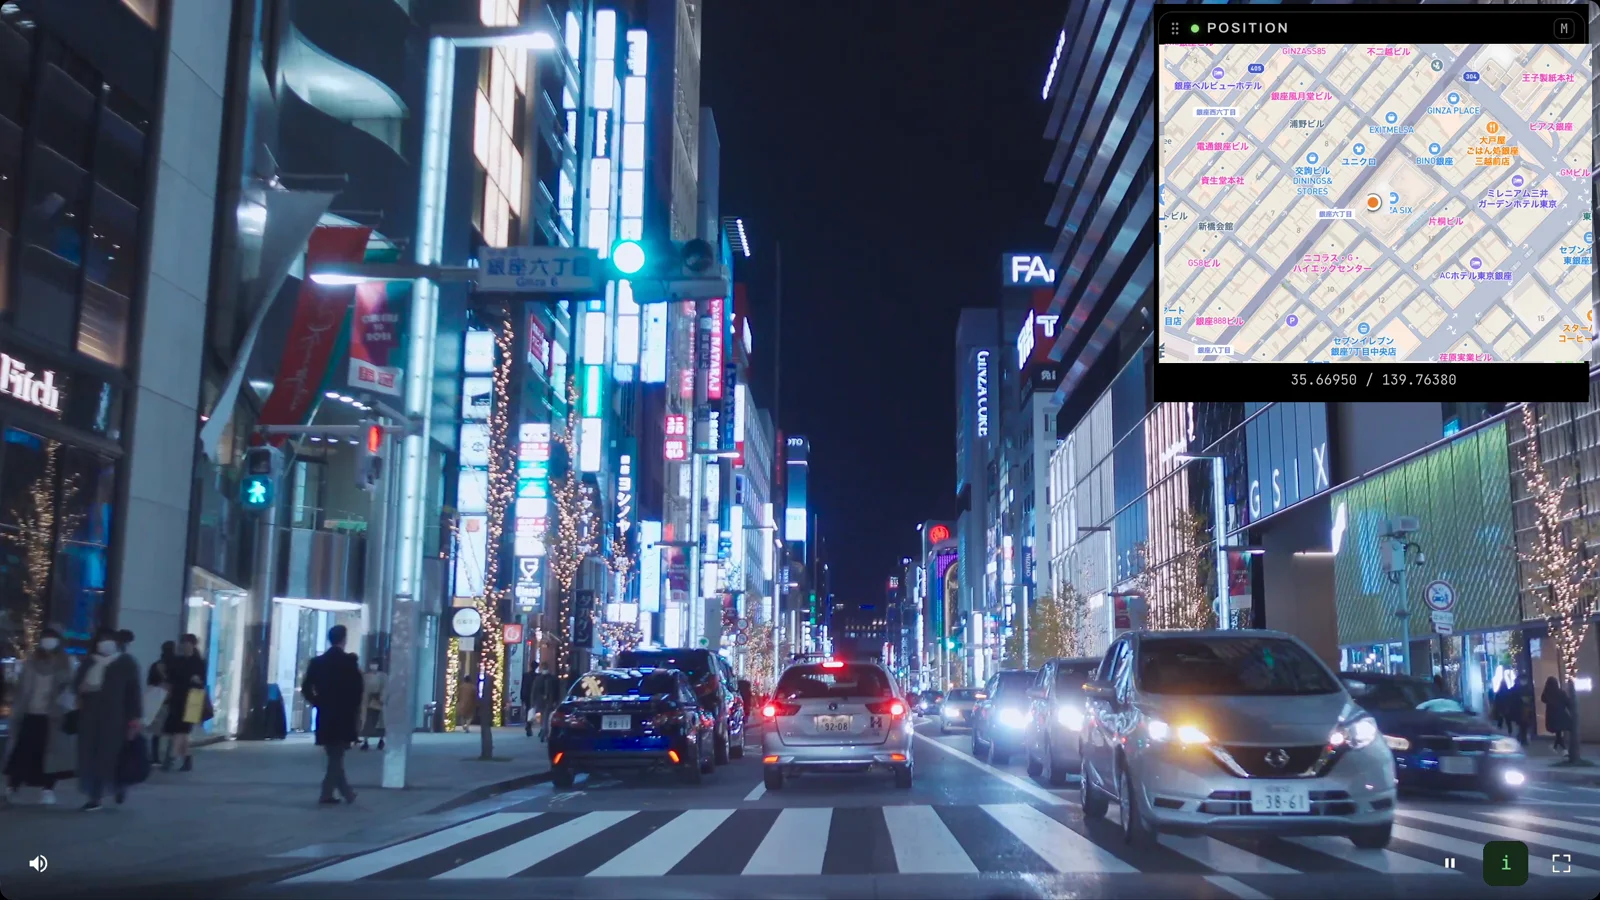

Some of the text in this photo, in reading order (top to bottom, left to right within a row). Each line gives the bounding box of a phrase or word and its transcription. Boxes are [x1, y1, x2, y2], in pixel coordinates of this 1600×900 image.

[1012, 256, 1055, 283] FA
[977, 350, 990, 397] GINZA
[825, 722, 848, 731] 92-08
[1265, 795, 1304, 809] 38-61
